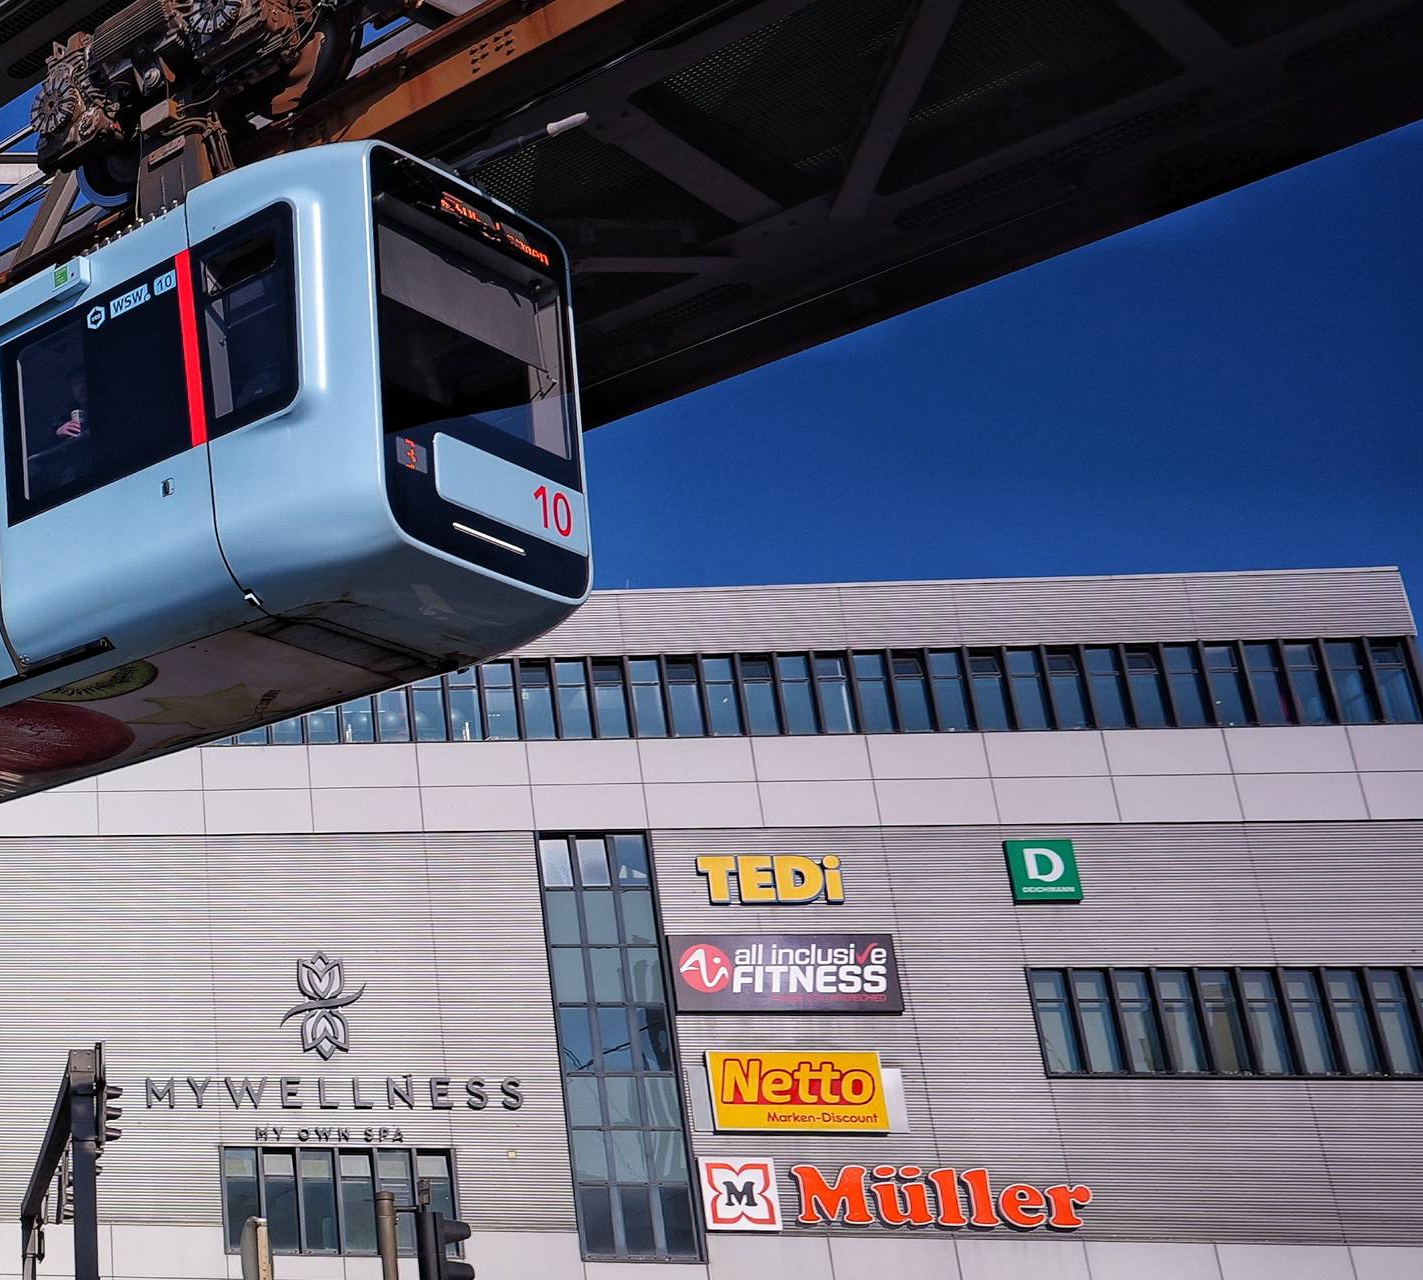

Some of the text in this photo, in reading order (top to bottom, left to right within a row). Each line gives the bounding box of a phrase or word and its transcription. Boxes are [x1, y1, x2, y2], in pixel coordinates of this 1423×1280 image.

[156, 274, 172, 292] 10
[533, 485, 573, 537] 10
[695, 854, 845, 905] TEDi
[1022, 847, 1065, 882] D
[734, 943, 763, 965] all
[732, 965, 887, 993] FITNESS
[145, 1075, 525, 1111] MYWELLNESS
[720, 1058, 876, 1106] Netto
[766, 1111, 879, 1124] Marken-Discount
[254, 1126, 405, 1143] MY OWN SPA
[722, 1180, 756, 1208] M
[790, 1164, 1092, 1229] Müller
